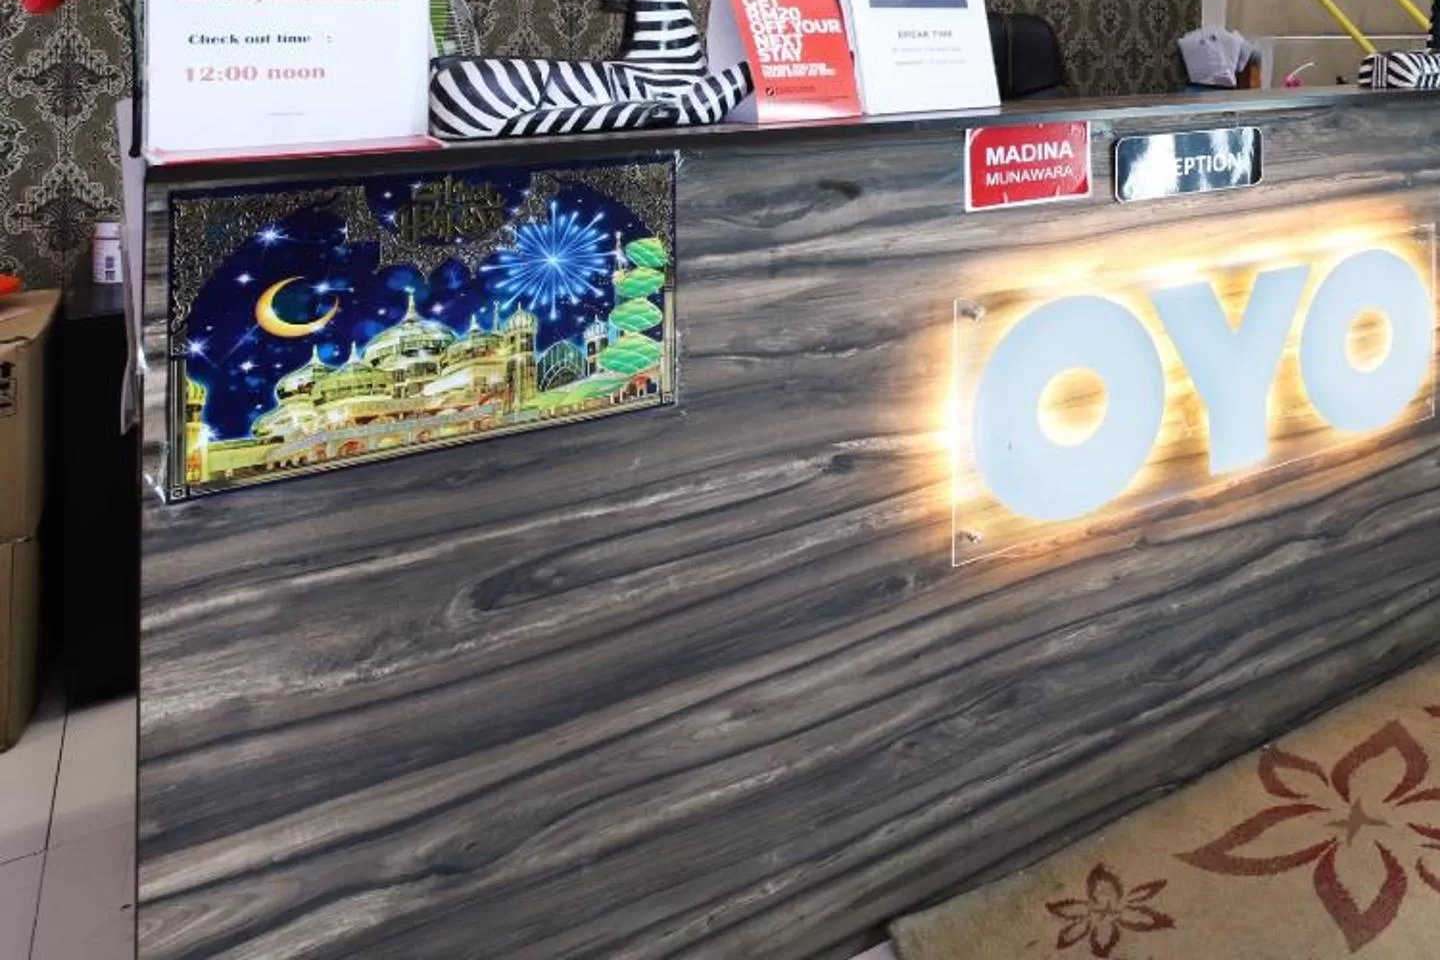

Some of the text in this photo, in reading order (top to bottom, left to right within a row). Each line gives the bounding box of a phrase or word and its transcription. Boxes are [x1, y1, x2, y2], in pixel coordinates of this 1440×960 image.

[746, 6, 801, 22] RM20
[750, 18, 842, 35] OFF YOUR
[188, 34, 240, 45] Check
[244, 34, 271, 45] out
[277, 34, 311, 45] time
[753, 33, 803, 49] NEXT
[757, 46, 803, 62] STAY
[185, 66, 326, 83] 12:00 noon
[985, 140, 1073, 166] MADINA
[1171, 152, 1243, 177] EPTION
[986, 163, 1073, 186] MUNAWARA
[973, 247, 1433, 523] OYO
